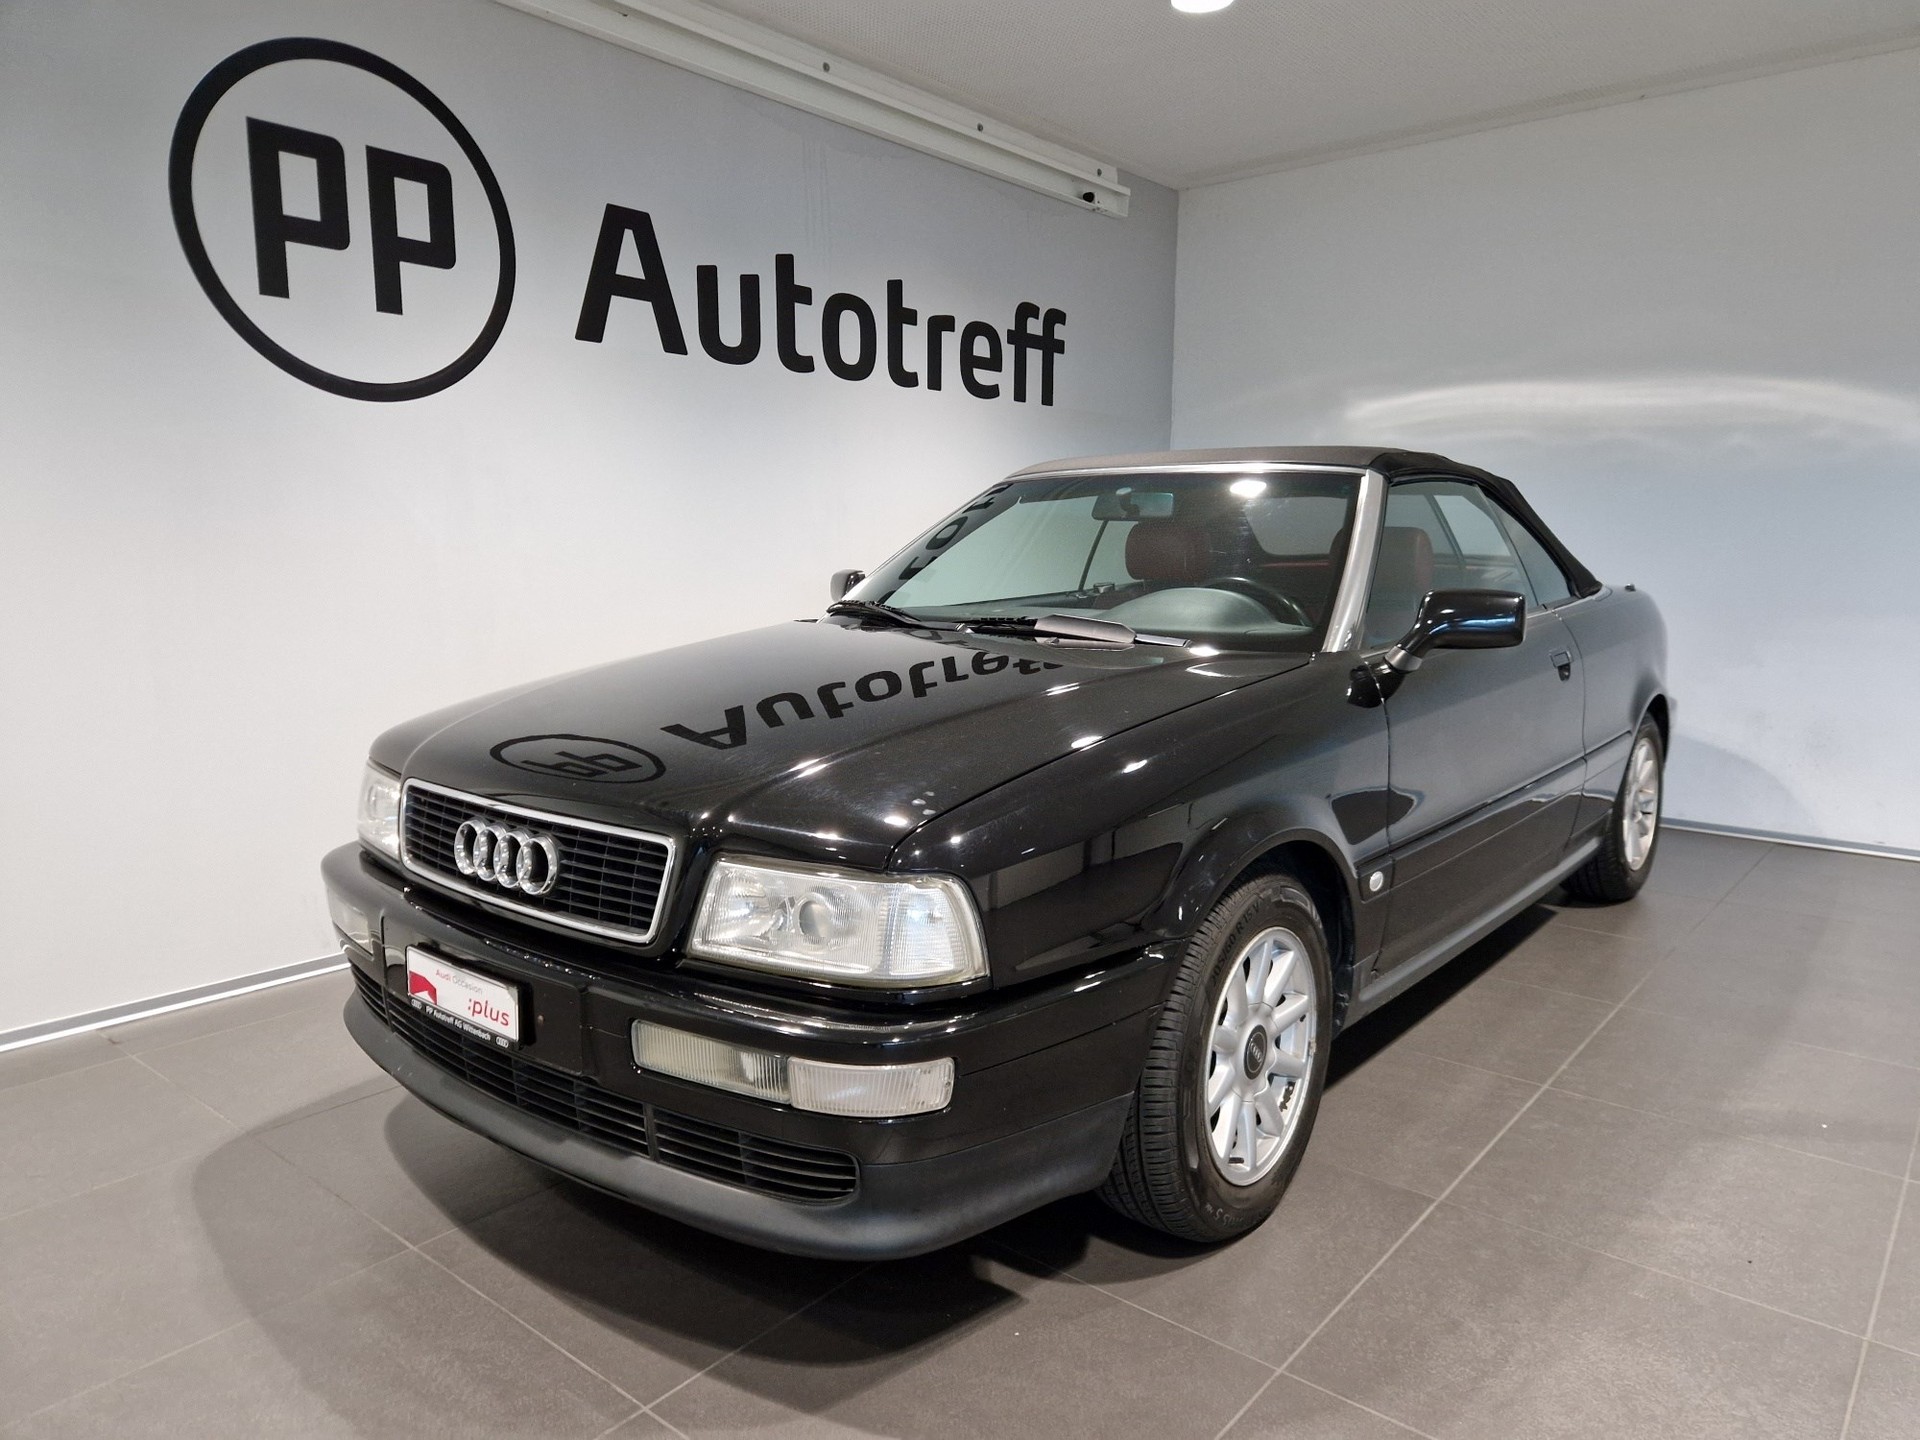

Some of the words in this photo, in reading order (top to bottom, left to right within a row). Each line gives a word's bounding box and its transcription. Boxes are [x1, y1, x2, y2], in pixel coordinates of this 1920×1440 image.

[246, 116, 456, 315] PP
[575, 203, 1066, 406] Autotreff
[436, 969, 451, 982] Audi
[452, 975, 482, 995] Occasion
[425, 1005, 434, 1015] PP
[454, 1018, 463, 1029] AG
[468, 998, 510, 1026] :plus
